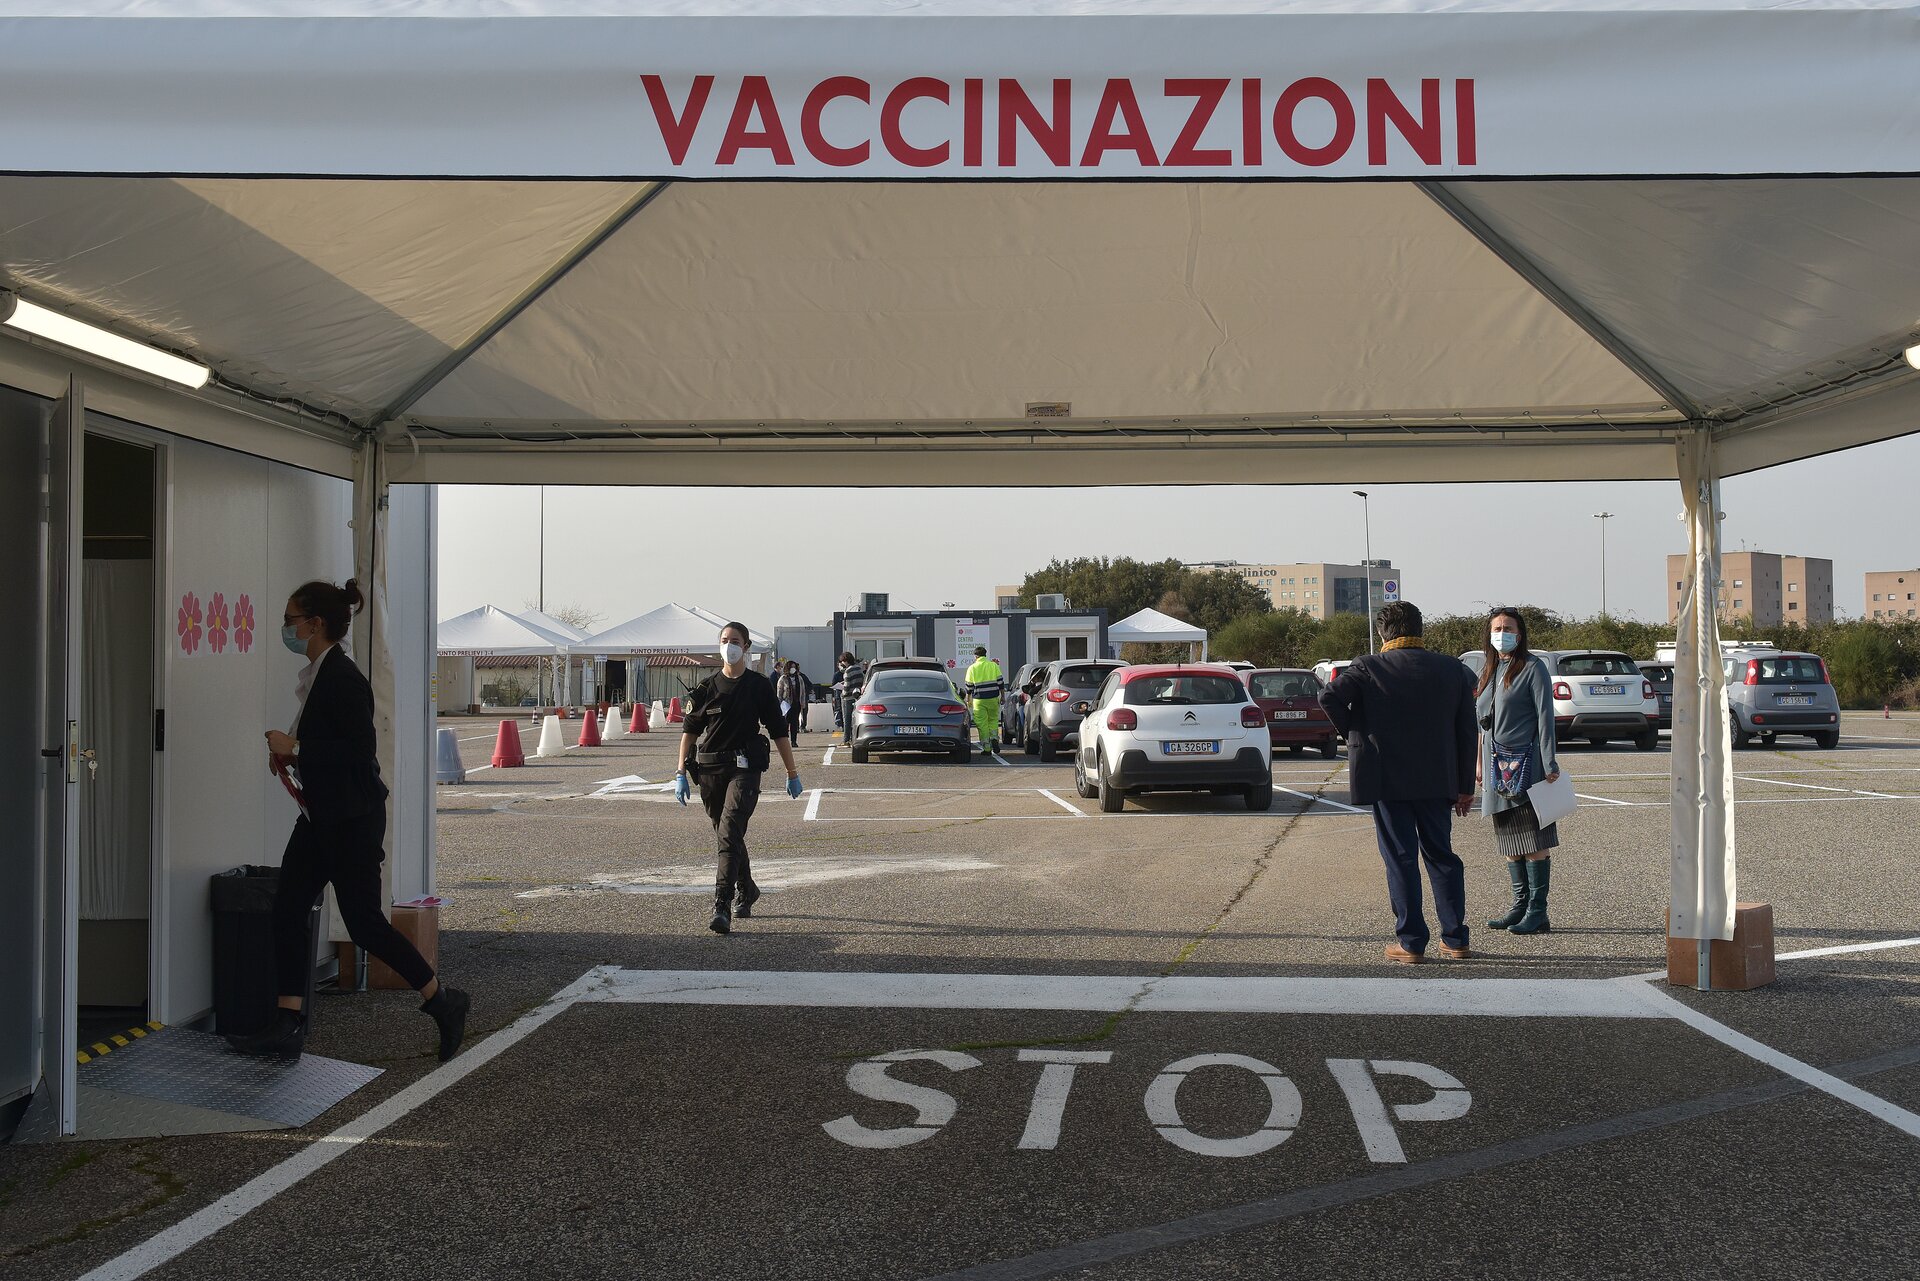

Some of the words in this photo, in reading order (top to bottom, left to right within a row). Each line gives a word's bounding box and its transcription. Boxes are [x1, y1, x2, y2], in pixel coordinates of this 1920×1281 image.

[640, 74, 1478, 168] VACCINAZIONI
[1215, 567, 1277, 580] liclinico
[822, 1048, 1473, 1164] STOP
